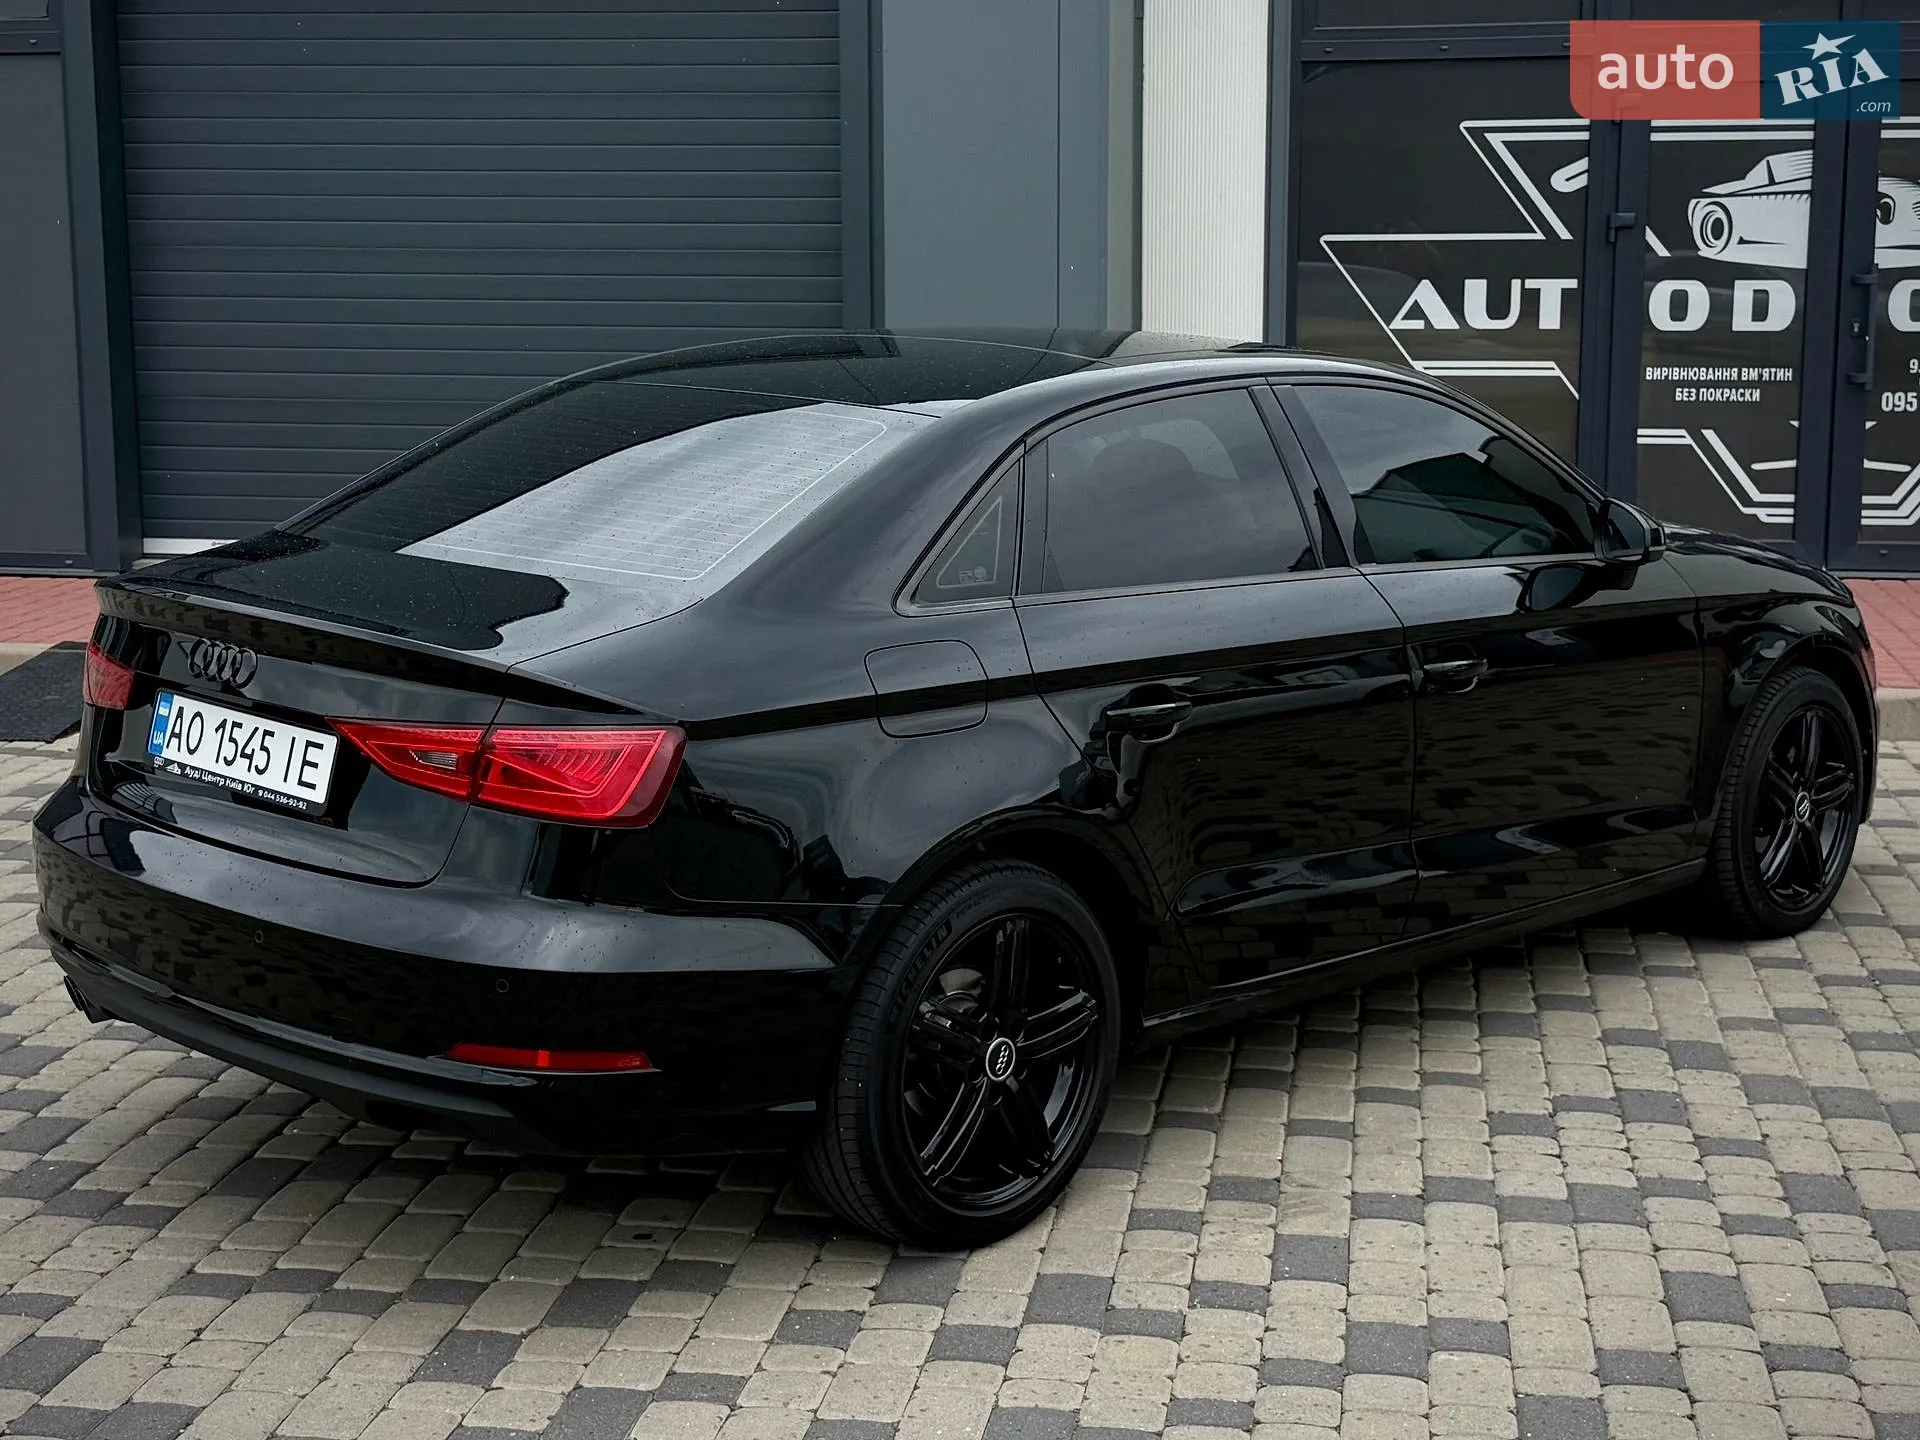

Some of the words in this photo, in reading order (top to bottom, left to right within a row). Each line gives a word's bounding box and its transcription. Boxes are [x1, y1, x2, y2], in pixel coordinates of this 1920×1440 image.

[1645, 366, 1738, 381] ВИРІВНЮВАННЯ
[1741, 367, 1793, 381] ВМ'ЯТИН
[1675, 388, 1697, 401] БЕЗ
[1699, 388, 1761, 402] ПОКРАСКИ
[1881, 391, 1918, 412] 095
[152, 730, 164, 746] UA
[166, 705, 205, 756] AO
[214, 717, 276, 776] 1545
[283, 736, 324, 791] IE
[184, 765, 201, 779] Ауді
[201, 770, 225, 787] Центр
[225, 777, 242, 791] Київ
[243, 783, 255, 794] Юг
